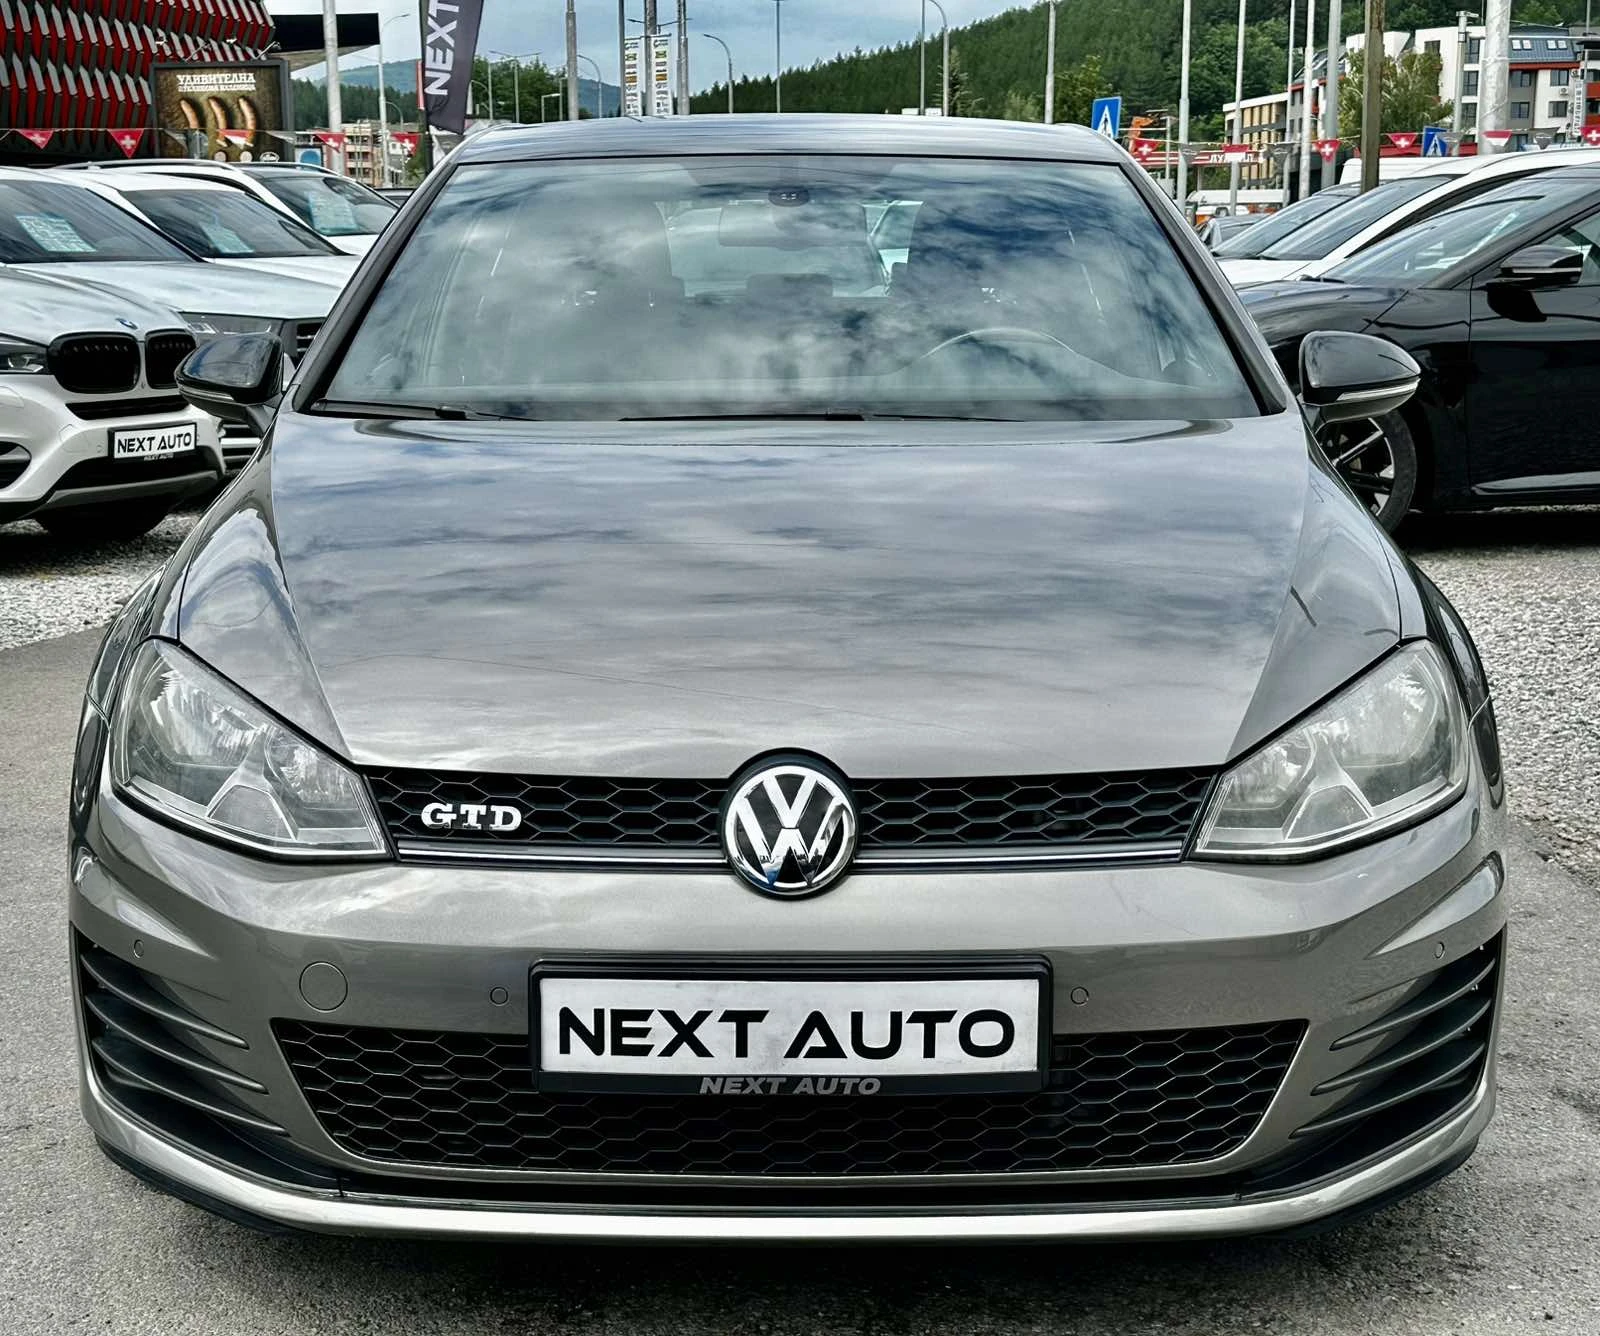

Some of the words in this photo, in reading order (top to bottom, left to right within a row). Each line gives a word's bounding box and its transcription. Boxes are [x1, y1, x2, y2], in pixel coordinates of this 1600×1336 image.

[424, 0, 460, 95] NEXT
[117, 436, 156, 454] NEXT
[157, 432, 192, 451] AUTO
[421, 803, 522, 831] GTD
[558, 1006, 769, 1058] NEXT
[783, 1008, 1016, 1060] AUTO
[699, 1076, 788, 1095] NEXT
[793, 1077, 881, 1096] AUTO
